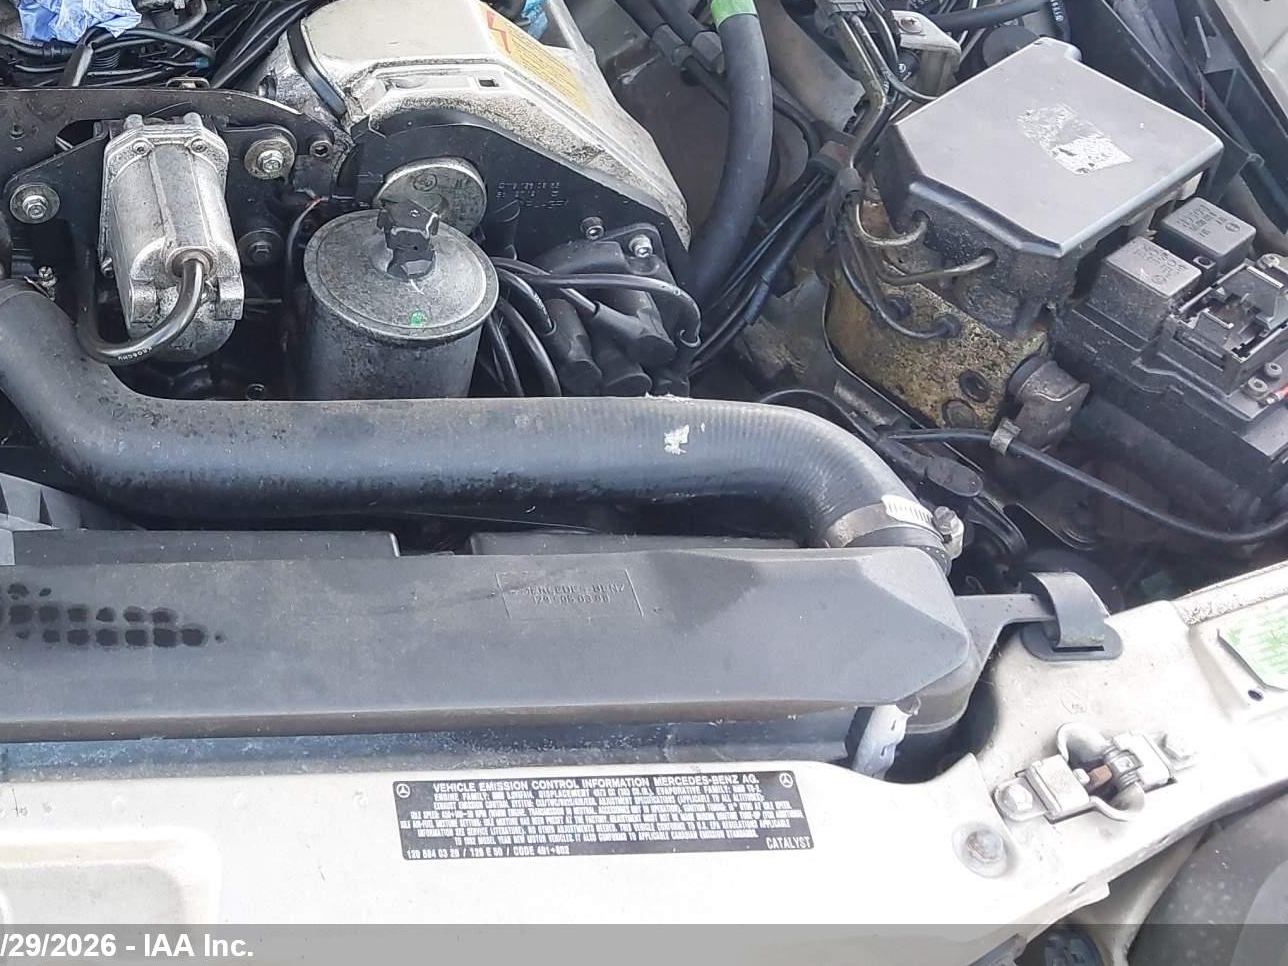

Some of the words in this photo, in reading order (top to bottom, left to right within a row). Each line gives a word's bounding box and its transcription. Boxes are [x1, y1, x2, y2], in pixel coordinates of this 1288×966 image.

[432, 782, 476, 792] VEHICLE
[478, 780, 528, 791] EMISSION
[530, 779, 579, 789] CONTROL
[581, 777, 650, 788] INFORMATION
[652, 775, 739, 786] MERCEDES-BENZ
[740, 774, 759, 784] AG.
[766, 836, 811, 849] CATALYST
